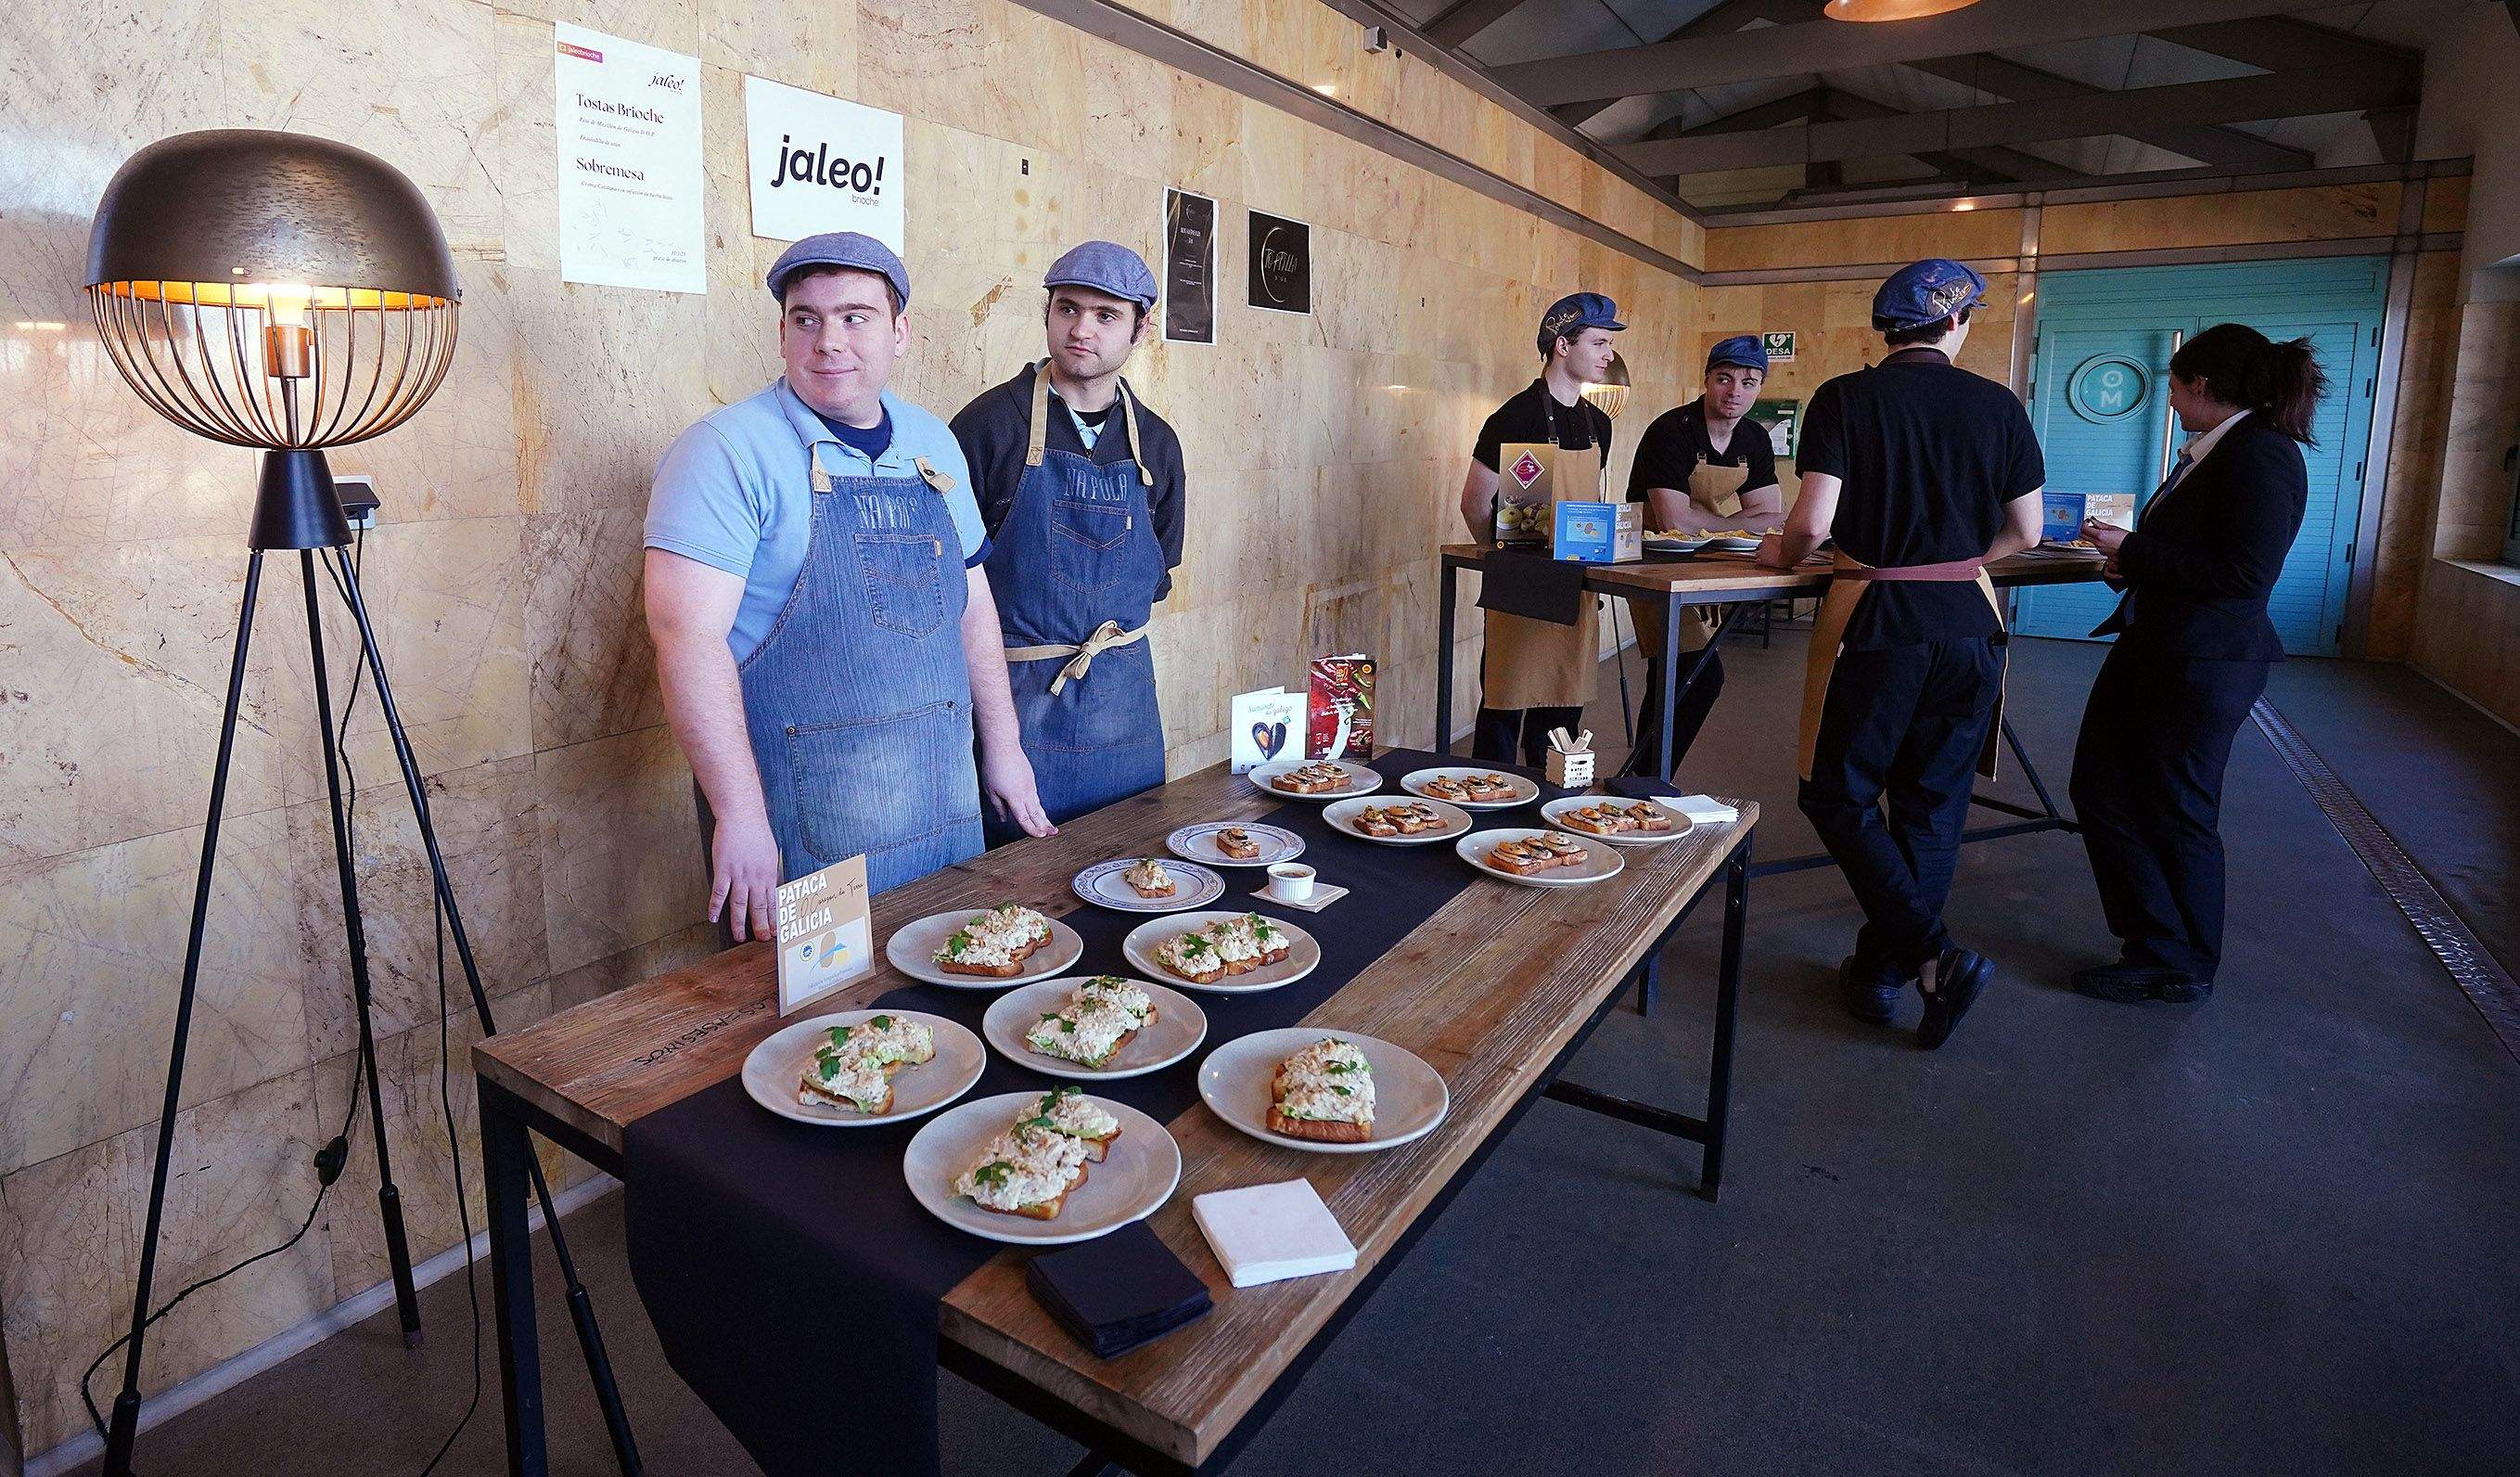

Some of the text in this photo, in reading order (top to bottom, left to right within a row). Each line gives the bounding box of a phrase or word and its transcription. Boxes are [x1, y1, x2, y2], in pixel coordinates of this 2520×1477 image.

[567, 46, 600, 59] jaleobrioche
[648, 72, 684, 91] jaleo!
[576, 94, 665, 123] Tostas Brioche
[576, 158, 645, 180] Sobremesa
[771, 135, 885, 195] jaleo!
[851, 194, 879, 206] brioche
[2086, 508, 2114, 517] GALICIA
[779, 873, 827, 907] PATACA
[779, 903, 798, 926] DE
[780, 907, 833, 944] GALICIA
